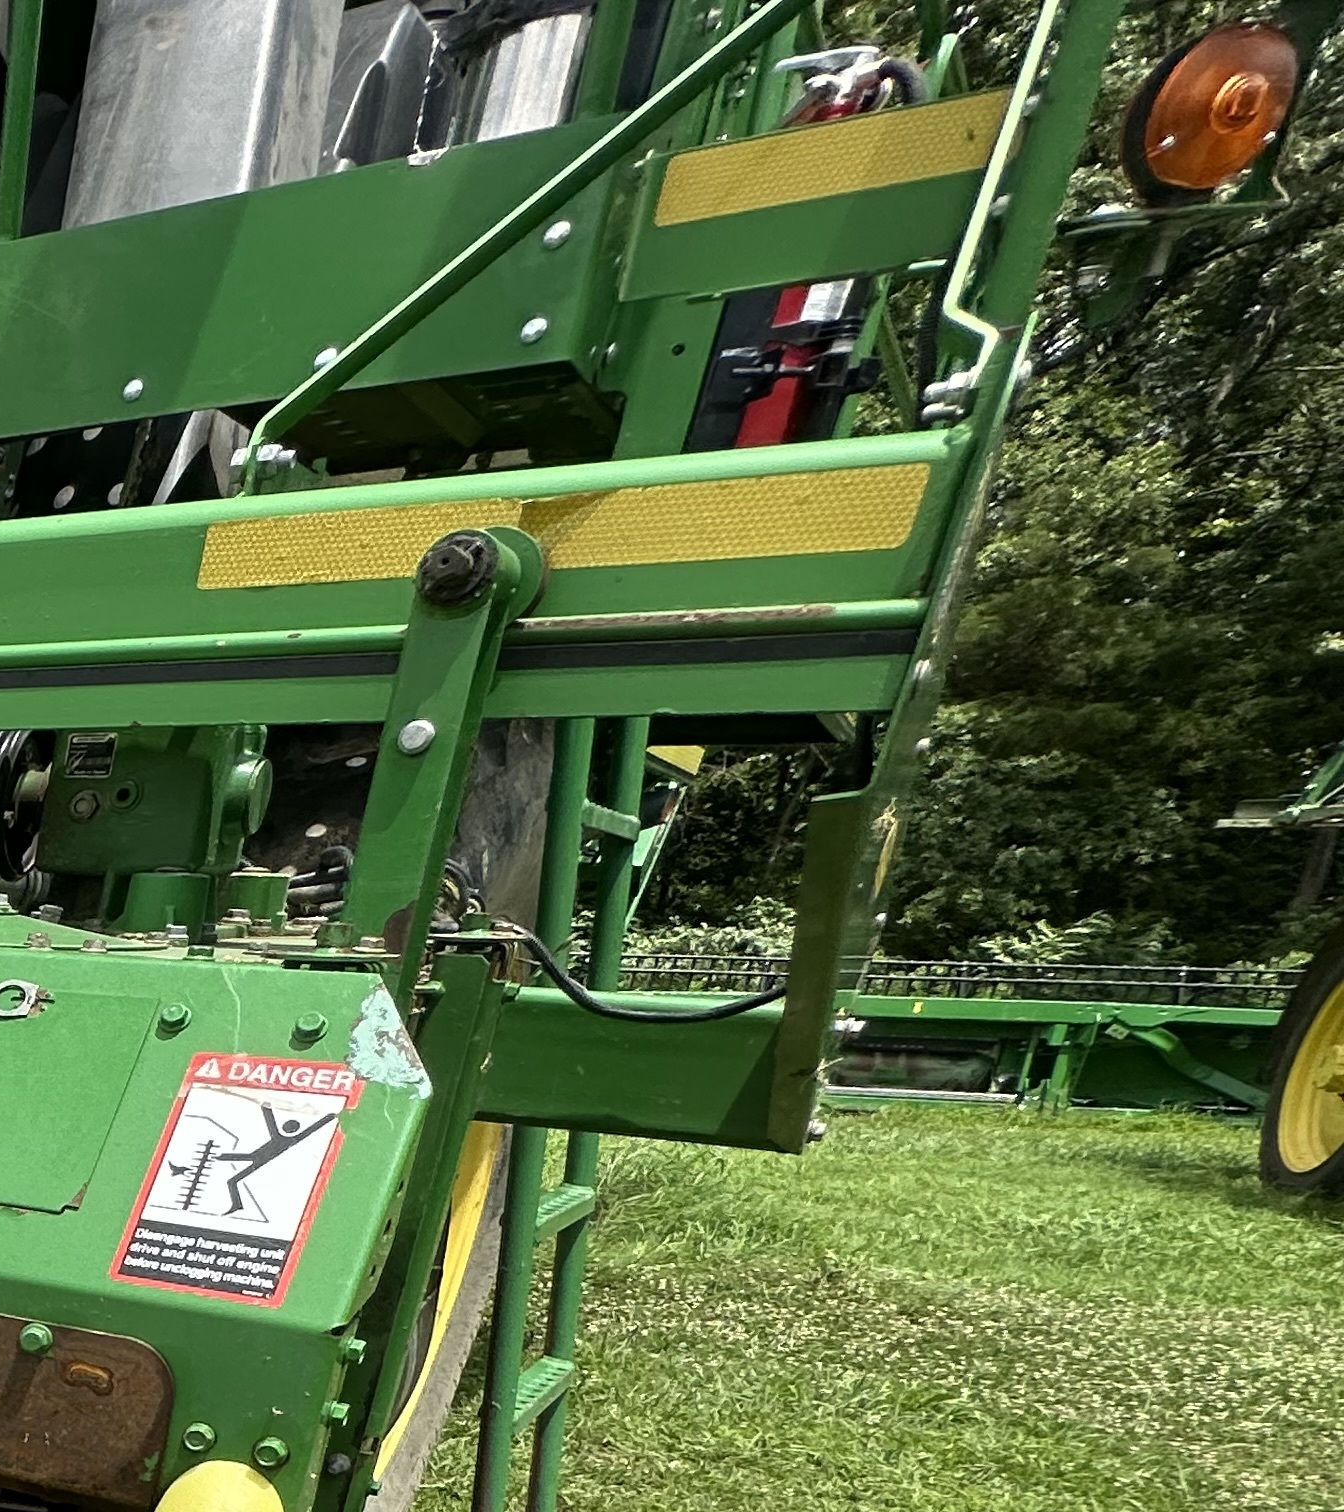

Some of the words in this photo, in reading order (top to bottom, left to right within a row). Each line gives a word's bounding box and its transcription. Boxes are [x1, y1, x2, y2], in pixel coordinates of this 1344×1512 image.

[227, 1062, 356, 1091] DANGER
[128, 1242, 160, 1256] drive
[161, 1248, 187, 1259] and
[187, 1251, 216, 1264] shut
[216, 1255, 236, 1267] off
[235, 1260, 280, 1275] engine
[134, 1227, 196, 1248] Disengage
[196, 1237, 259, 1258] harvesting
[260, 1248, 286, 1261] unit
[124, 1255, 160, 1270] before
[160, 1261, 223, 1282] unclogging
